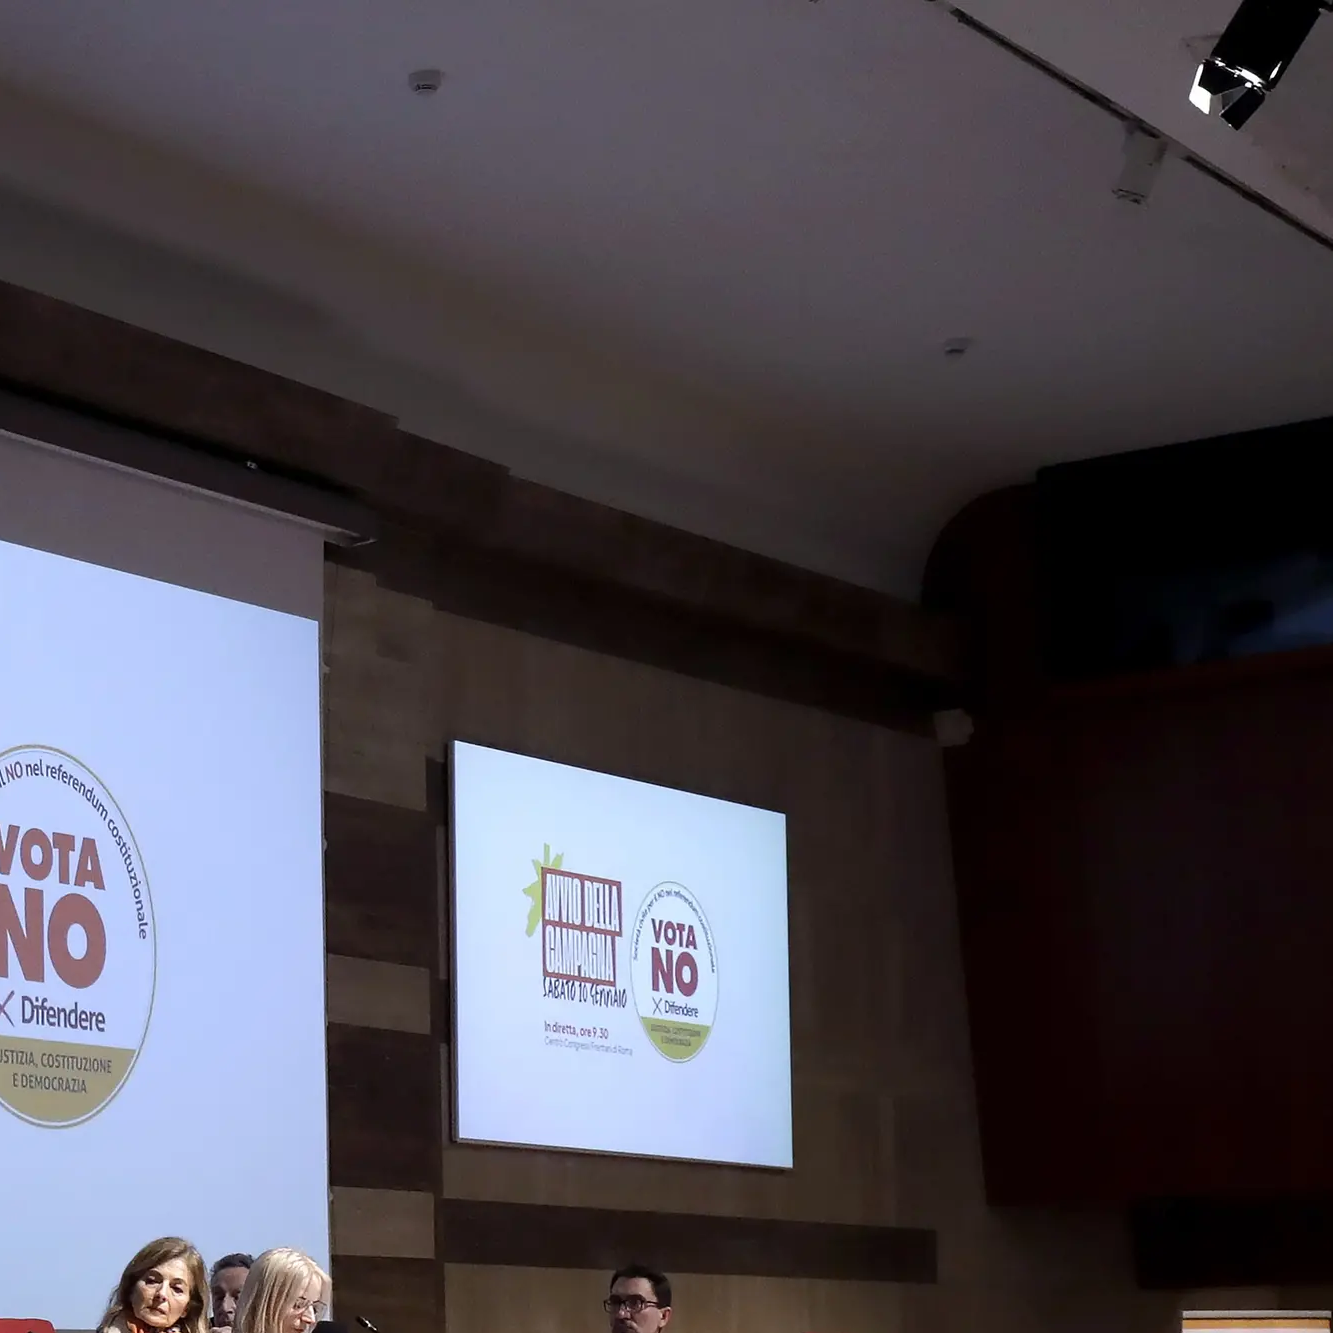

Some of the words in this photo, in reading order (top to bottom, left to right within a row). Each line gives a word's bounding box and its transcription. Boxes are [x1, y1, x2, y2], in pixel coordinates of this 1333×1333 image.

[5, 761, 23, 783] NO
[25, 759, 44, 778] nel
[45, 763, 108, 821] referendum
[107, 819, 149, 940] costituzionale
[545, 873, 581, 925] AVVIO
[584, 880, 620, 932] DELLA
[651, 917, 697, 950] VOTA
[546, 925, 614, 981] CAMPAGNA
[651, 946, 699, 997] NO
[543, 977, 576, 1001] SABATO
[579, 982, 587, 1002] 10
[21, 995, 106, 1032] Difendere
[665, 1000, 698, 1018] Difendere
[580, 1027, 591, 1037] ore
[41, 1053, 112, 1074] COSTITUZIONE
[12, 1073, 19, 1087] E
[21, 1074, 87, 1094] DEMOCRAZIA
